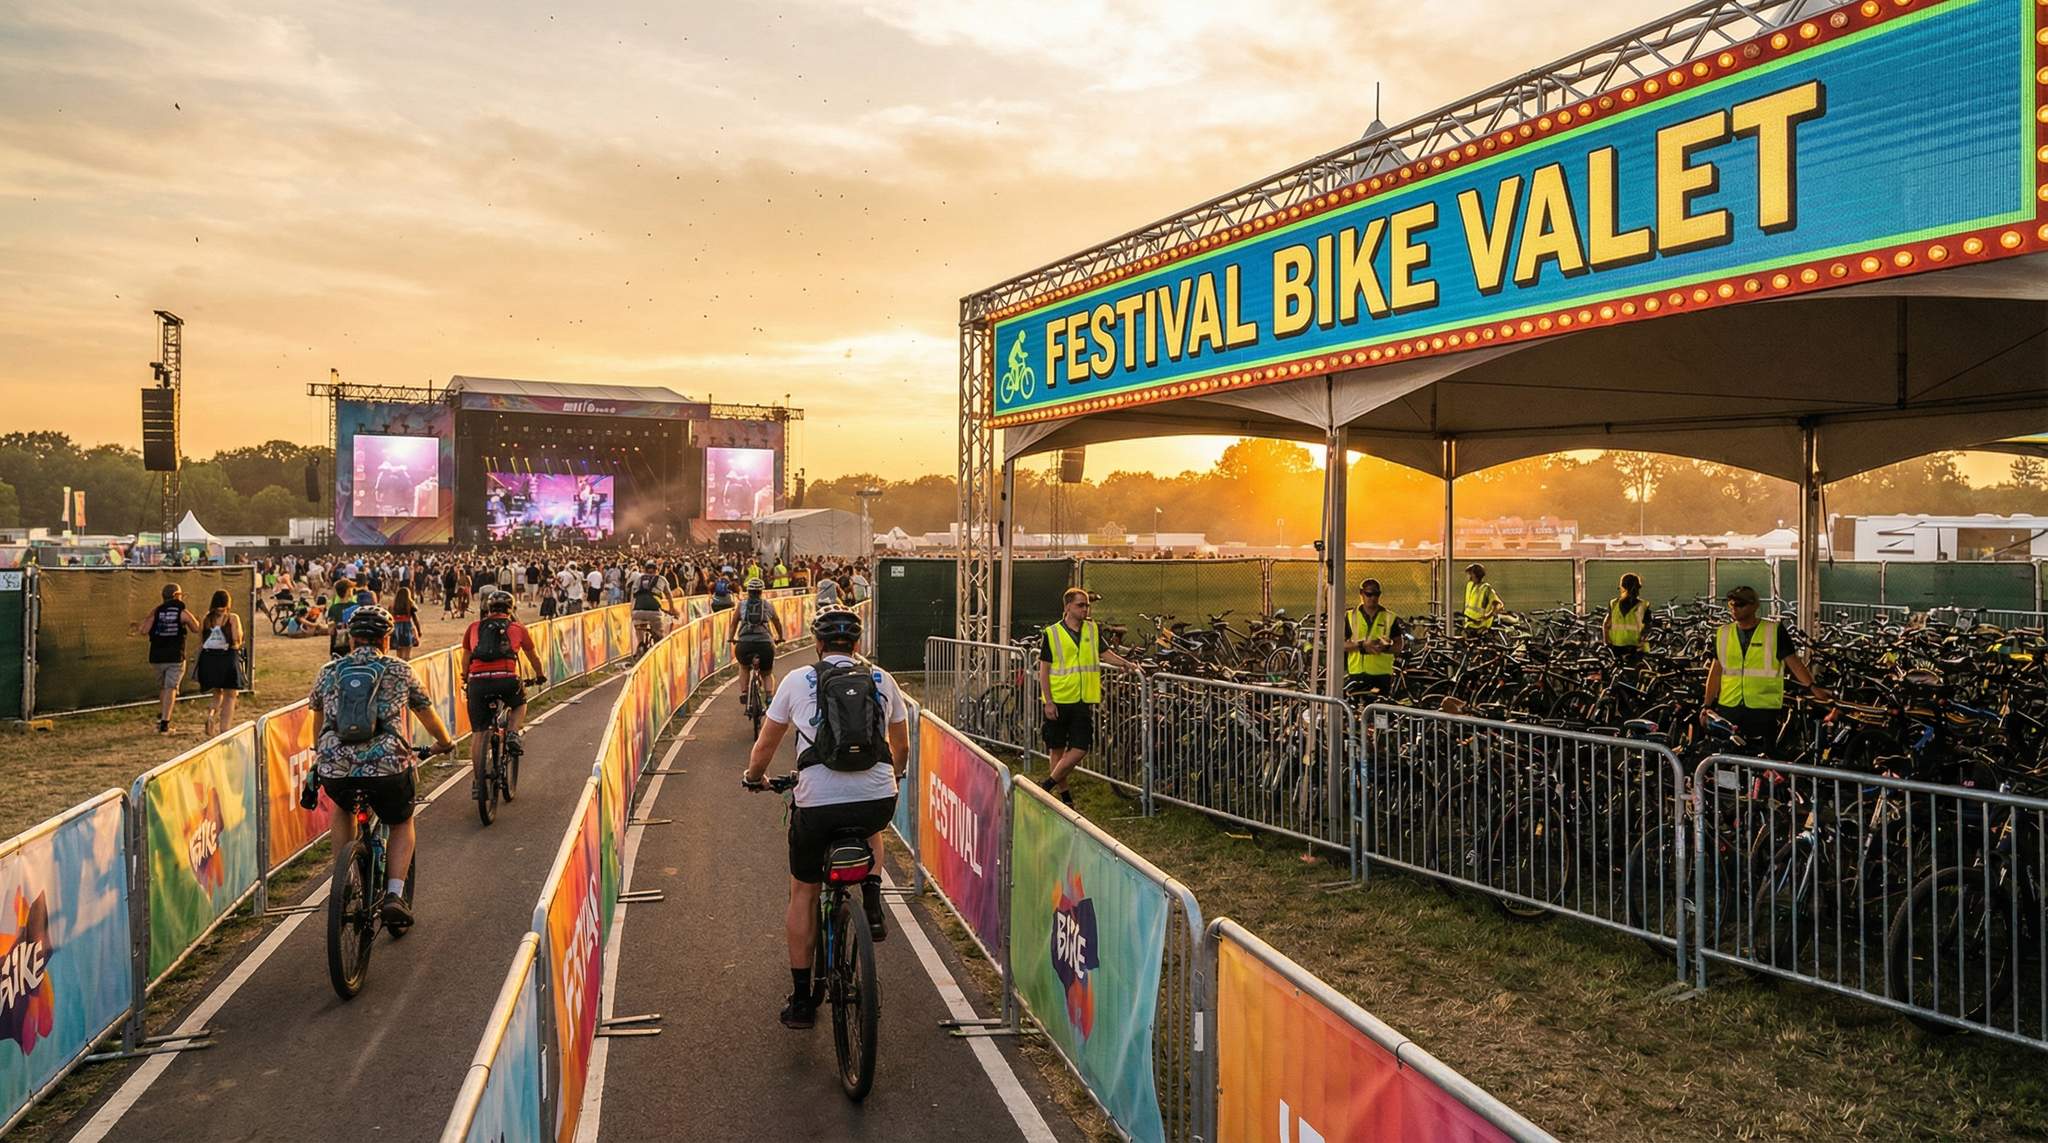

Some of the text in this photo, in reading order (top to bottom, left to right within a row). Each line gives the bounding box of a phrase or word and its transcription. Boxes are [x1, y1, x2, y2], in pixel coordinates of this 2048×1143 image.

[1046, 80, 1822, 388] FESTIVAL BIKE VALET
[929, 770, 983, 878] FESTIVAL
